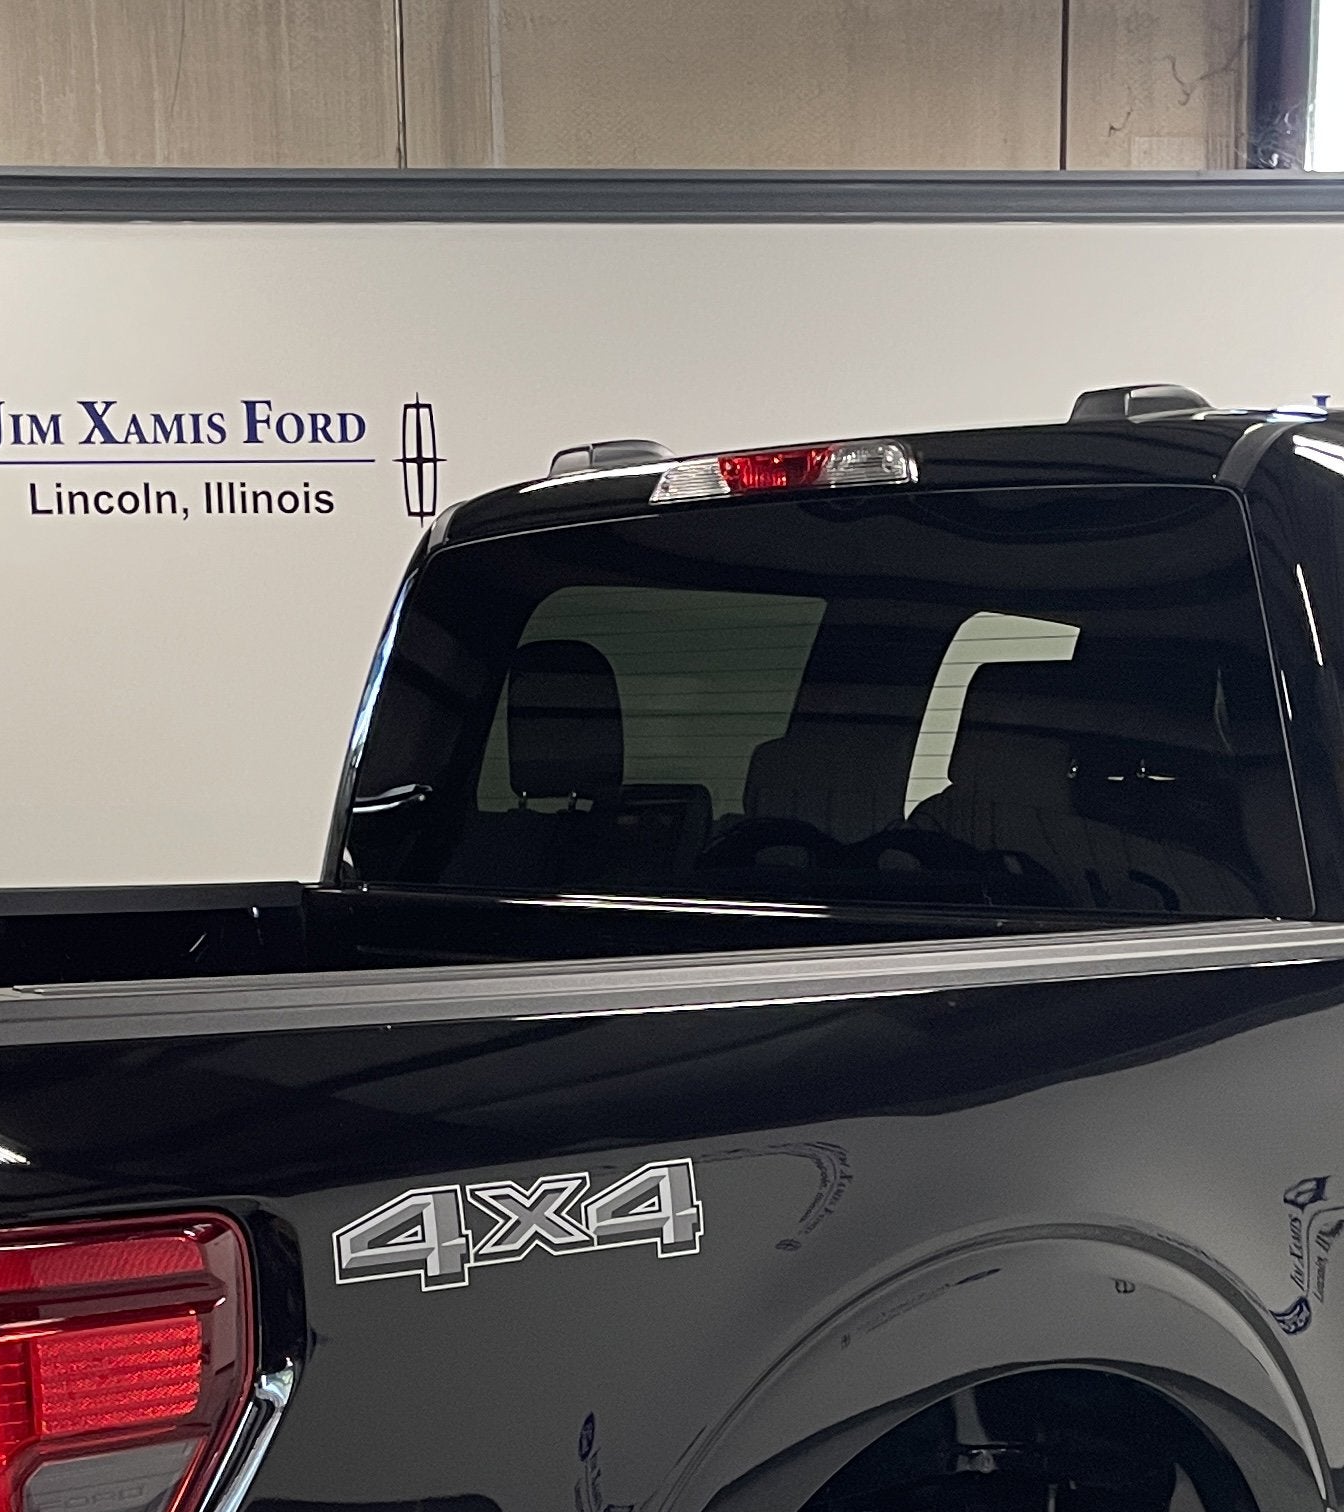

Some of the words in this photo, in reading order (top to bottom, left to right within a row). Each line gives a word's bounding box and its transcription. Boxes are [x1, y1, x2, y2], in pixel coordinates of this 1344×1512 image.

[78, 399, 227, 446] XAMIS
[240, 398, 367, 446] FORD
[29, 481, 190, 521] Lincoln,
[204, 480, 335, 515] Illinois
